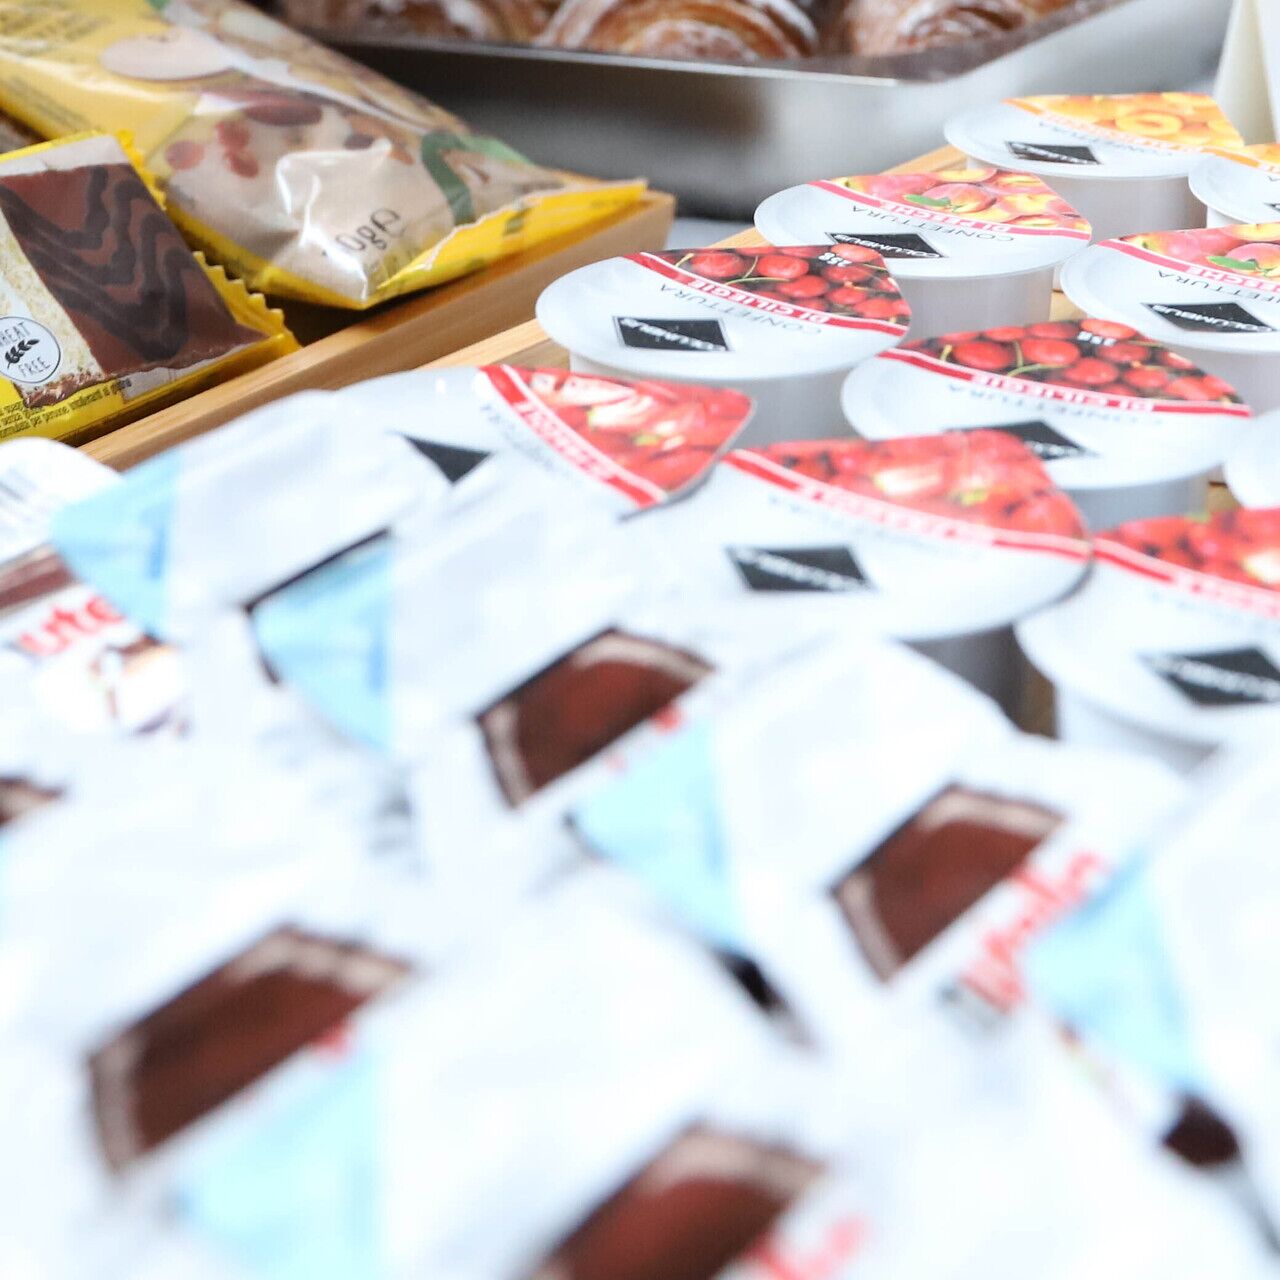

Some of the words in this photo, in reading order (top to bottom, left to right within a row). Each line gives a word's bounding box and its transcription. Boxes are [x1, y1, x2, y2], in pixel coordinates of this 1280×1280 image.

[853, 205, 1014, 242] CONFETTURA
[833, 233, 941, 258] COLUMBUS
[818, 252, 851, 268] 25g
[660, 283, 822, 334] CONFETTURA
[687, 278, 796, 320] CILIEGIE
[1152, 304, 1274, 332] COLUMBUS
[18, 356, 51, 377] FREE
